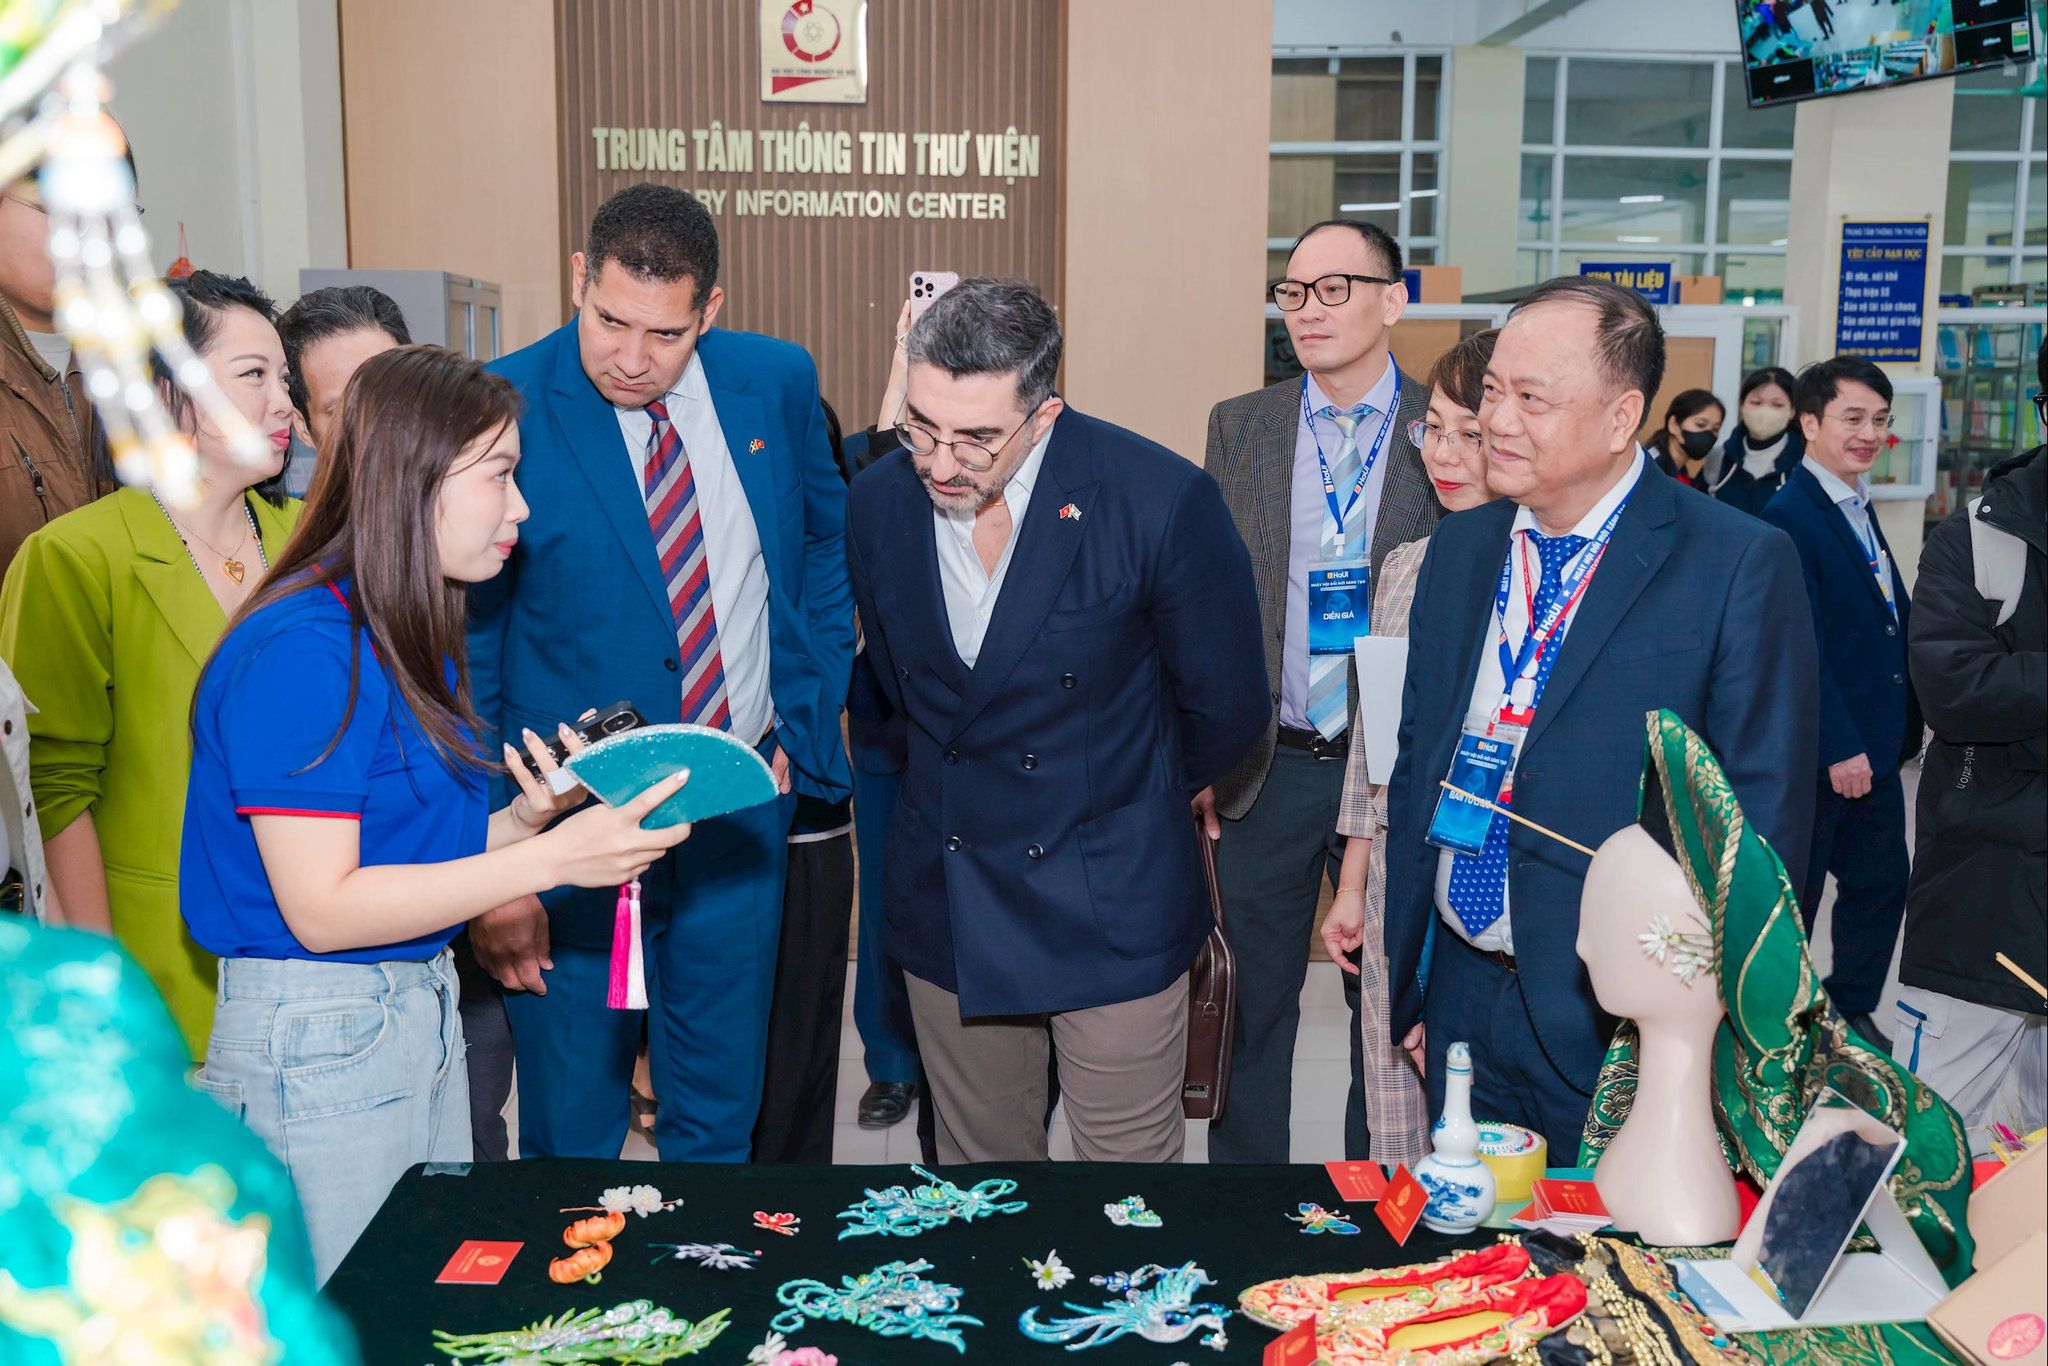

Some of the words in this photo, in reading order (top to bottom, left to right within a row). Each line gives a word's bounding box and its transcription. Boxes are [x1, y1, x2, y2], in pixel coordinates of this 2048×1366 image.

[592, 127, 686, 172] TRUNG
[692, 120, 753, 172] TÂM
[759, 121, 852, 174] THÔNG
[859, 131, 906, 175] TIN
[913, 129, 971, 177] THƯ
[976, 125, 1040, 185] VIỆN
[736, 189, 900, 218] INFORMATION
[906, 191, 1006, 219] CENTER
[1636, 268, 1664, 292] LIỆU
[1540, 602, 1563, 630] HaUI
